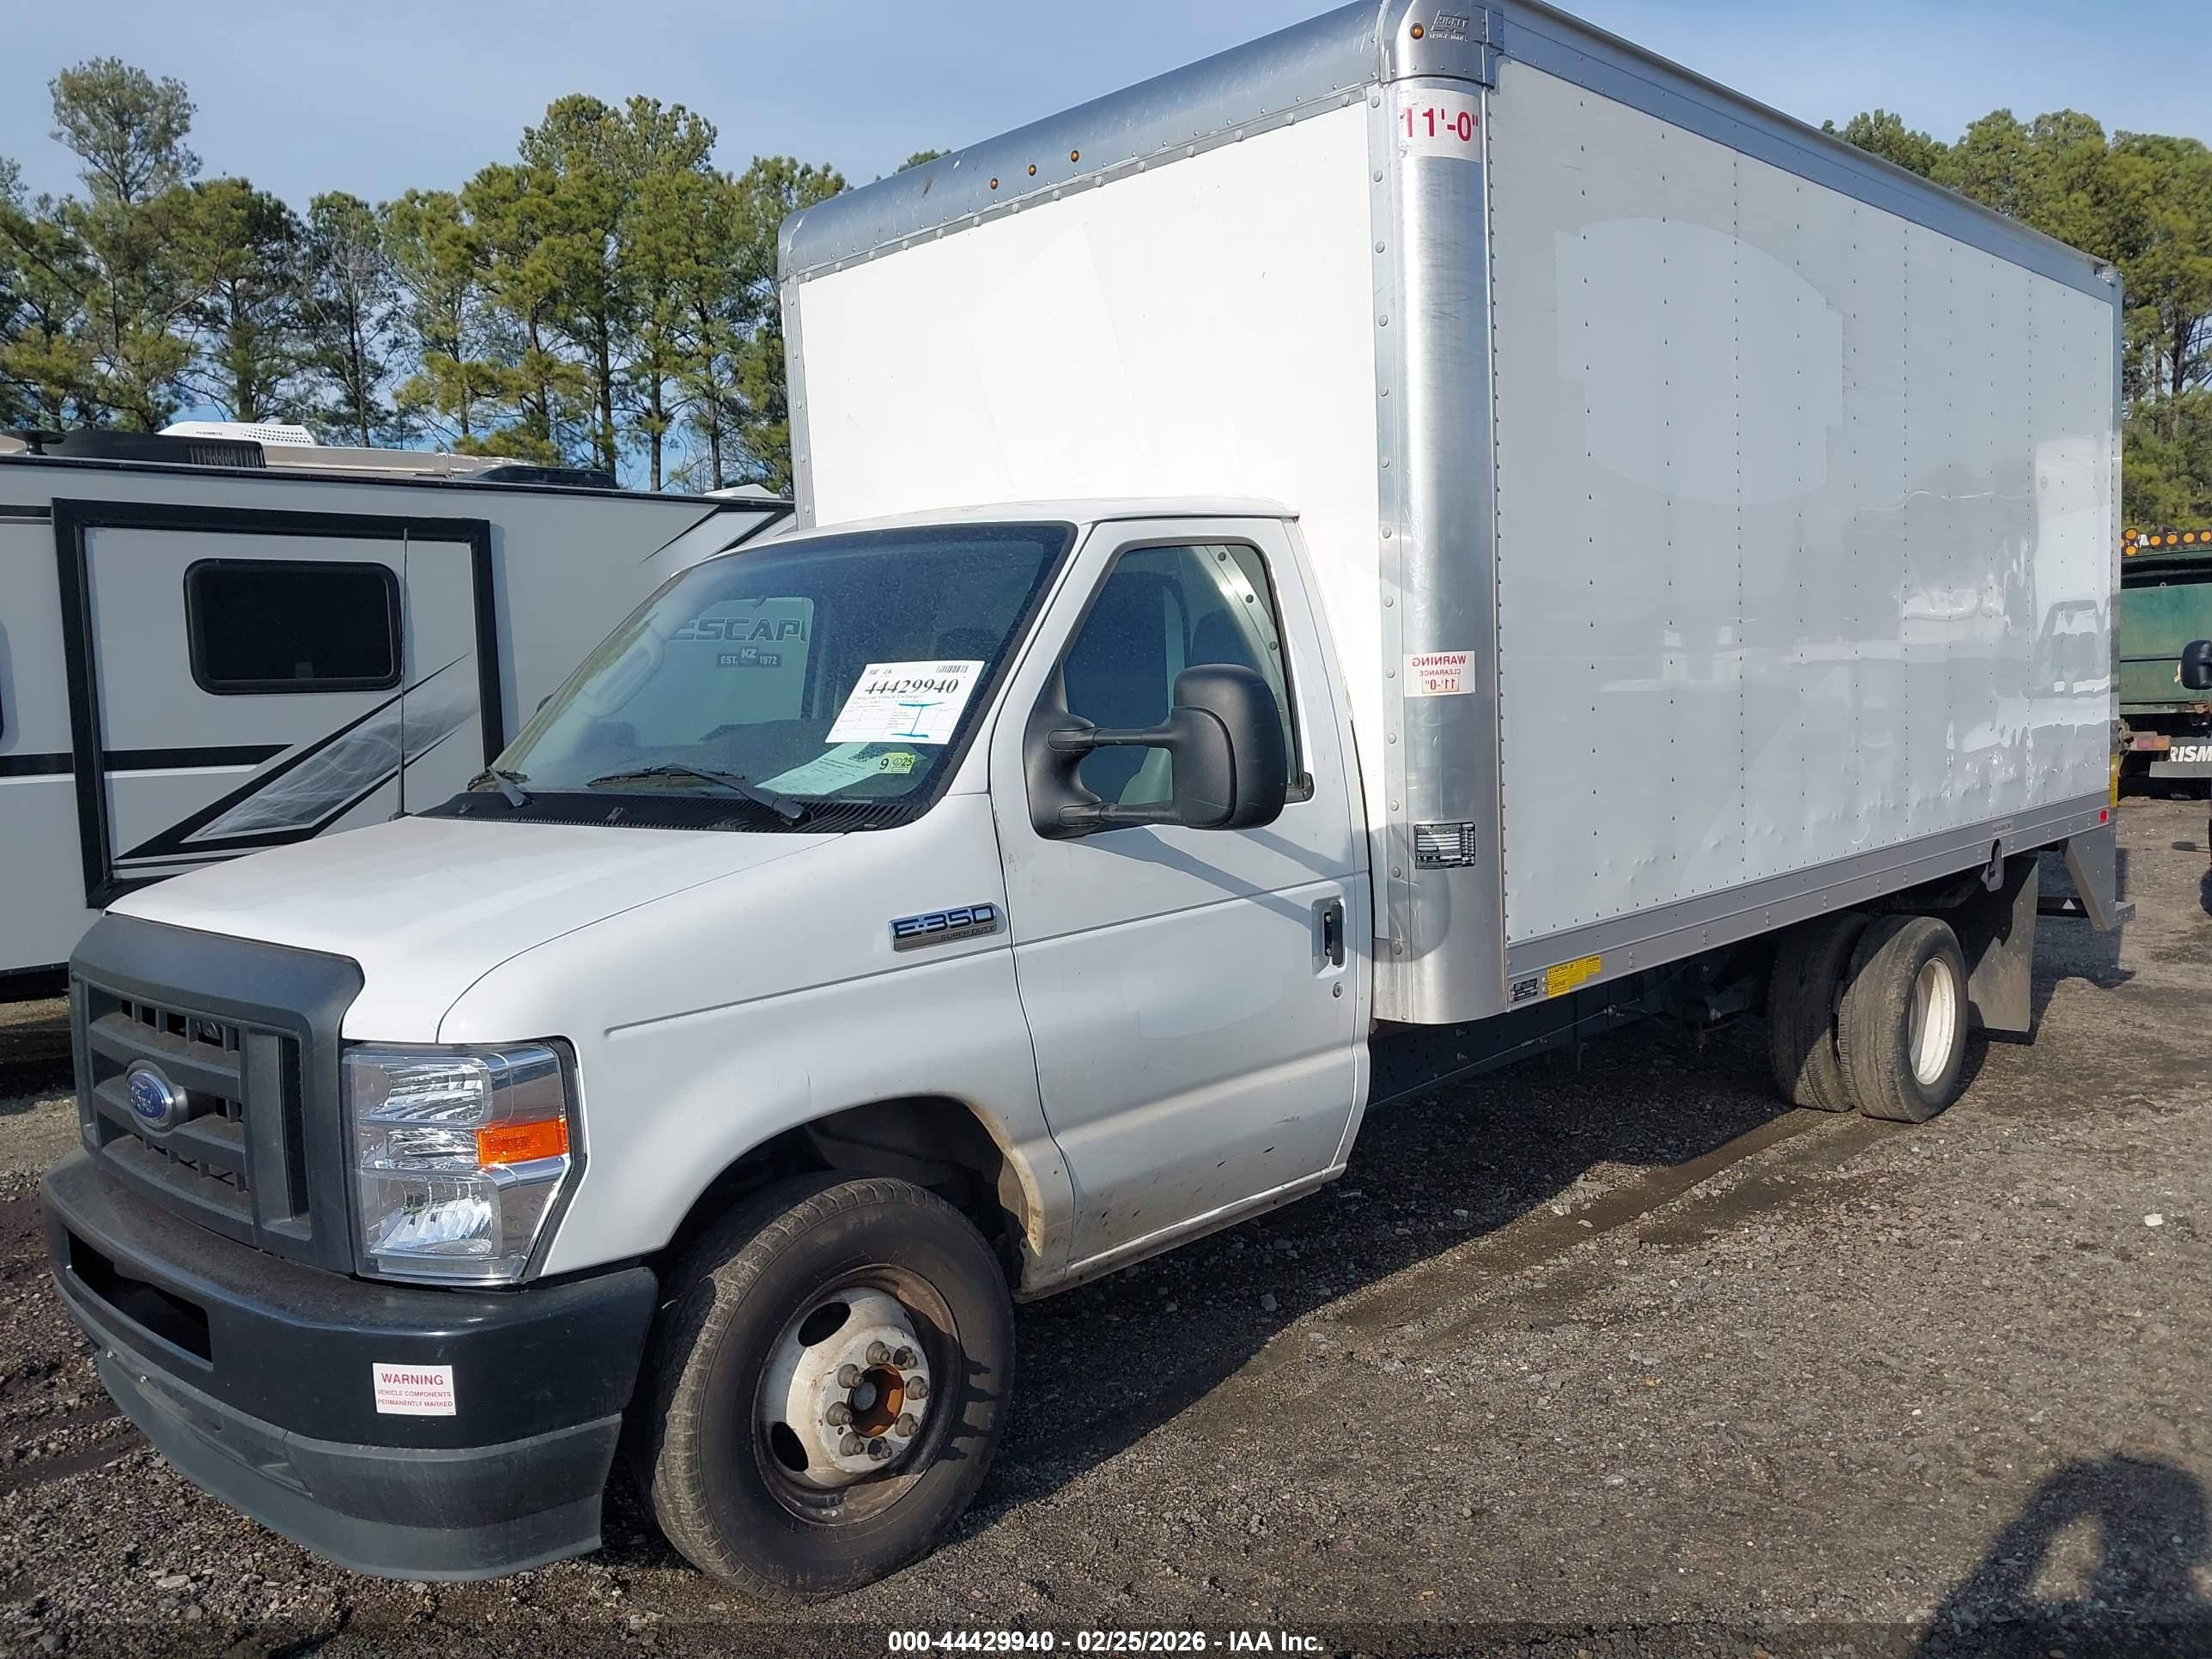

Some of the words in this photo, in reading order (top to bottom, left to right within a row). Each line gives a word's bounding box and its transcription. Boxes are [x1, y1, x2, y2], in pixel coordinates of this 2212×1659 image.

[1400, 107, 1479, 142] 11'-0"
[669, 617, 806, 643] ESCAP
[721, 655, 738, 665] EST.
[760, 655, 777, 665] 1972
[865, 678, 959, 695] 44429940
[878, 757, 890, 770] 9
[901, 757, 913, 767] 25
[893, 905, 994, 939] E-350
[940, 929, 969, 941] SUPER
[971, 927, 995, 935] DUTY
[381, 1373, 444, 1385] WARNING
